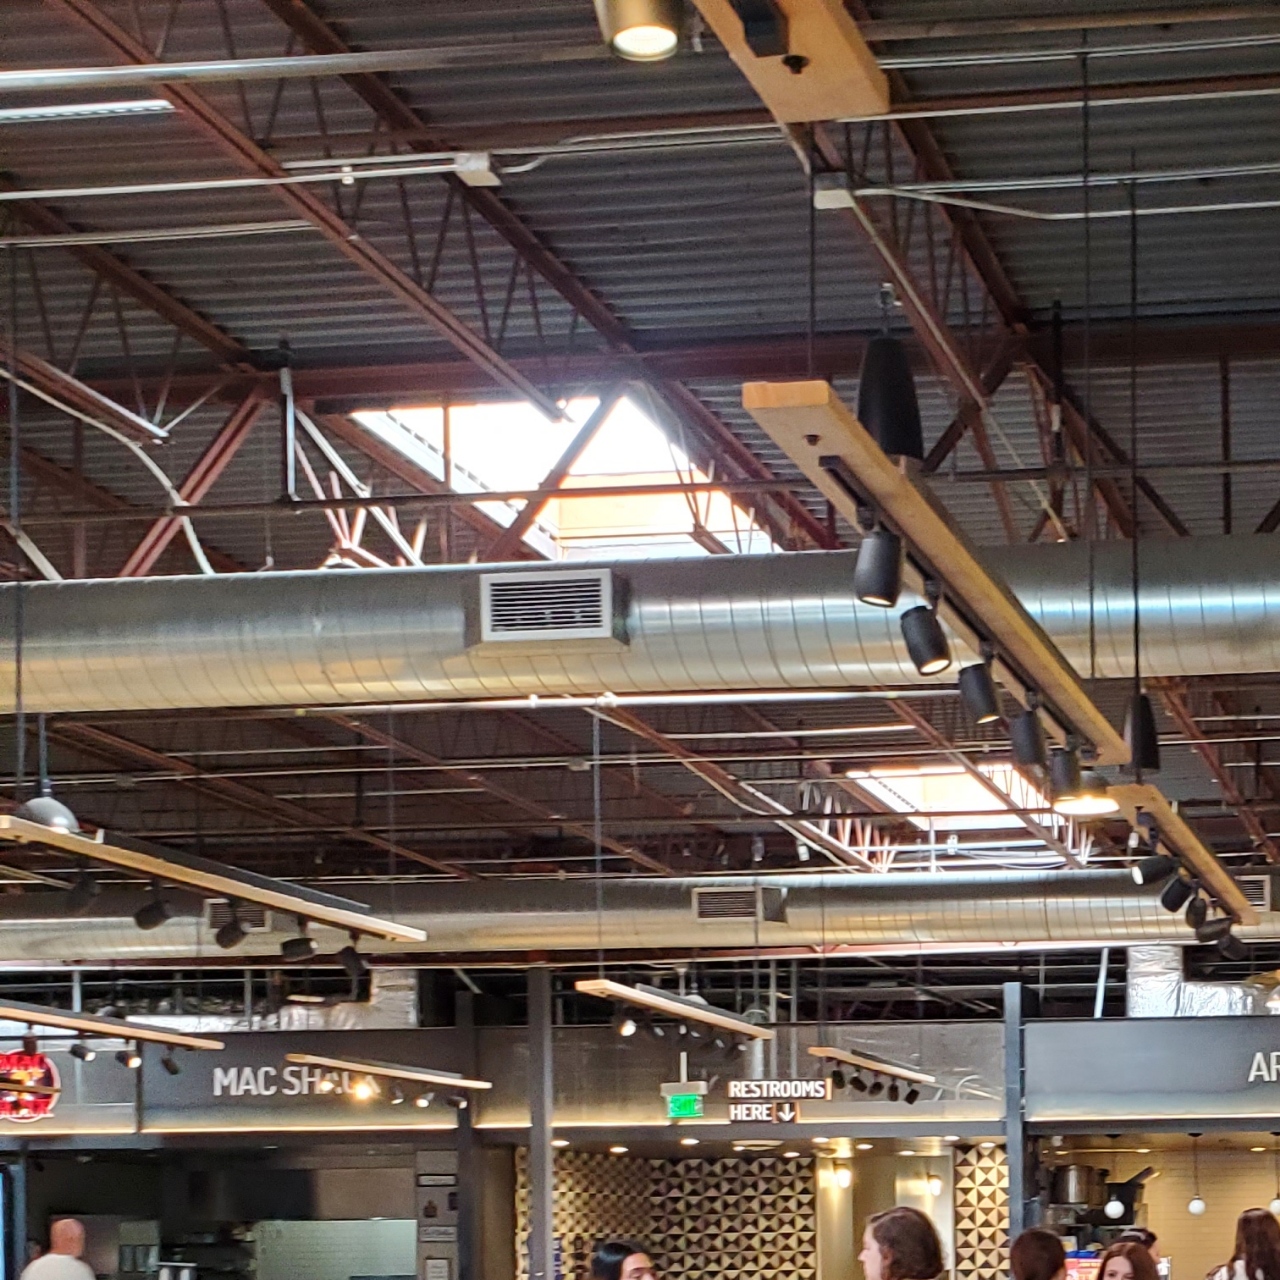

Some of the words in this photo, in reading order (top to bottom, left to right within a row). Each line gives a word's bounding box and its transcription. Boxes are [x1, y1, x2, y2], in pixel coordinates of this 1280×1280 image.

[213, 1066, 278, 1096] MAC
[729, 1080, 826, 1098] RESTROOMS
[730, 1104, 773, 1121] HERE
